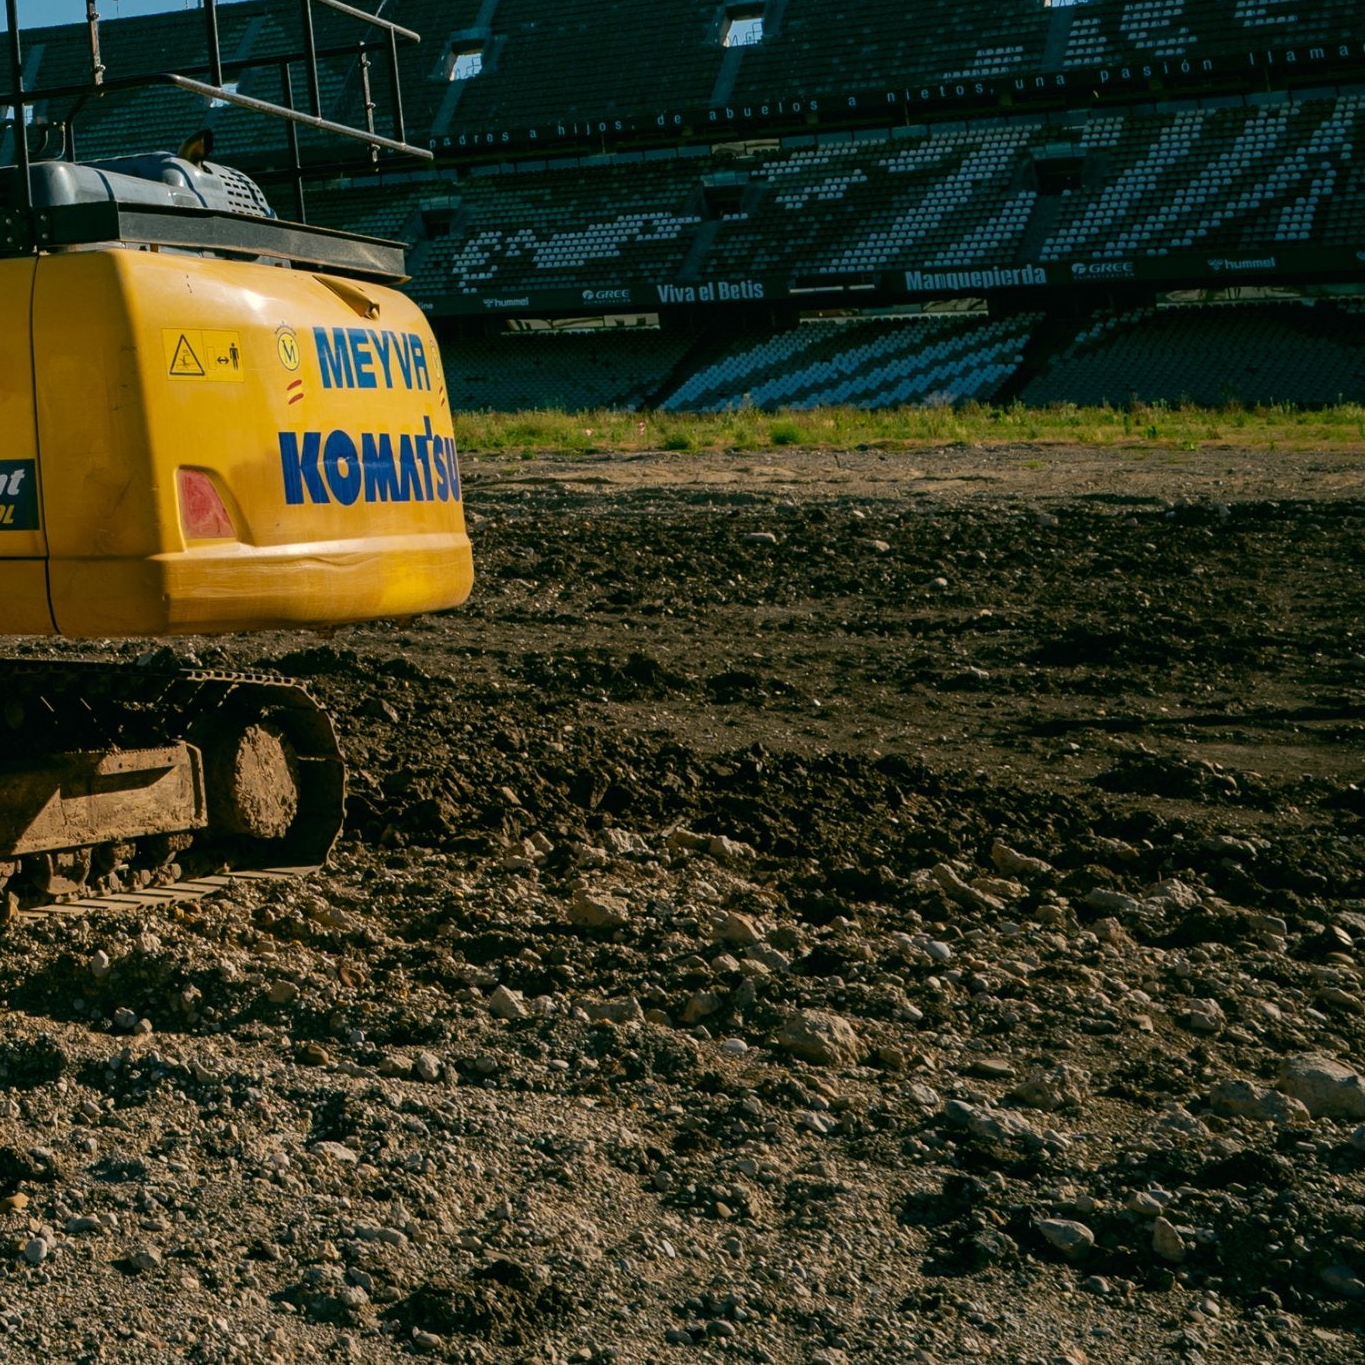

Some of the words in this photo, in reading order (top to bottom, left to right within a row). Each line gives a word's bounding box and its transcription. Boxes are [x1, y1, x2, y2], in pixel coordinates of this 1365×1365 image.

[429, 131, 509, 149] padres
[529, 129, 537, 139] a
[657, 113, 682, 127] de
[709, 100, 818, 121] abuelos
[848, 95, 856, 107] a
[887, 83, 994, 104] nietos,
[1015, 74, 1065, 90] una
[1100, 57, 1212, 83] pasión
[1249, 43, 1365, 66] llama
[1089, 262, 1134, 273] GREE
[1224, 257, 1275, 270] hummel
[905, 264, 1047, 291] Manquepierda
[494, 296, 529, 307] hummel
[596, 289, 630, 299] GREE
[657, 285, 695, 303] Viva
[699, 282, 714, 301] el
[719, 280, 764, 300] Betis
[312, 326, 432, 391] MEYVA
[278, 415, 461, 507] KOMATSU
